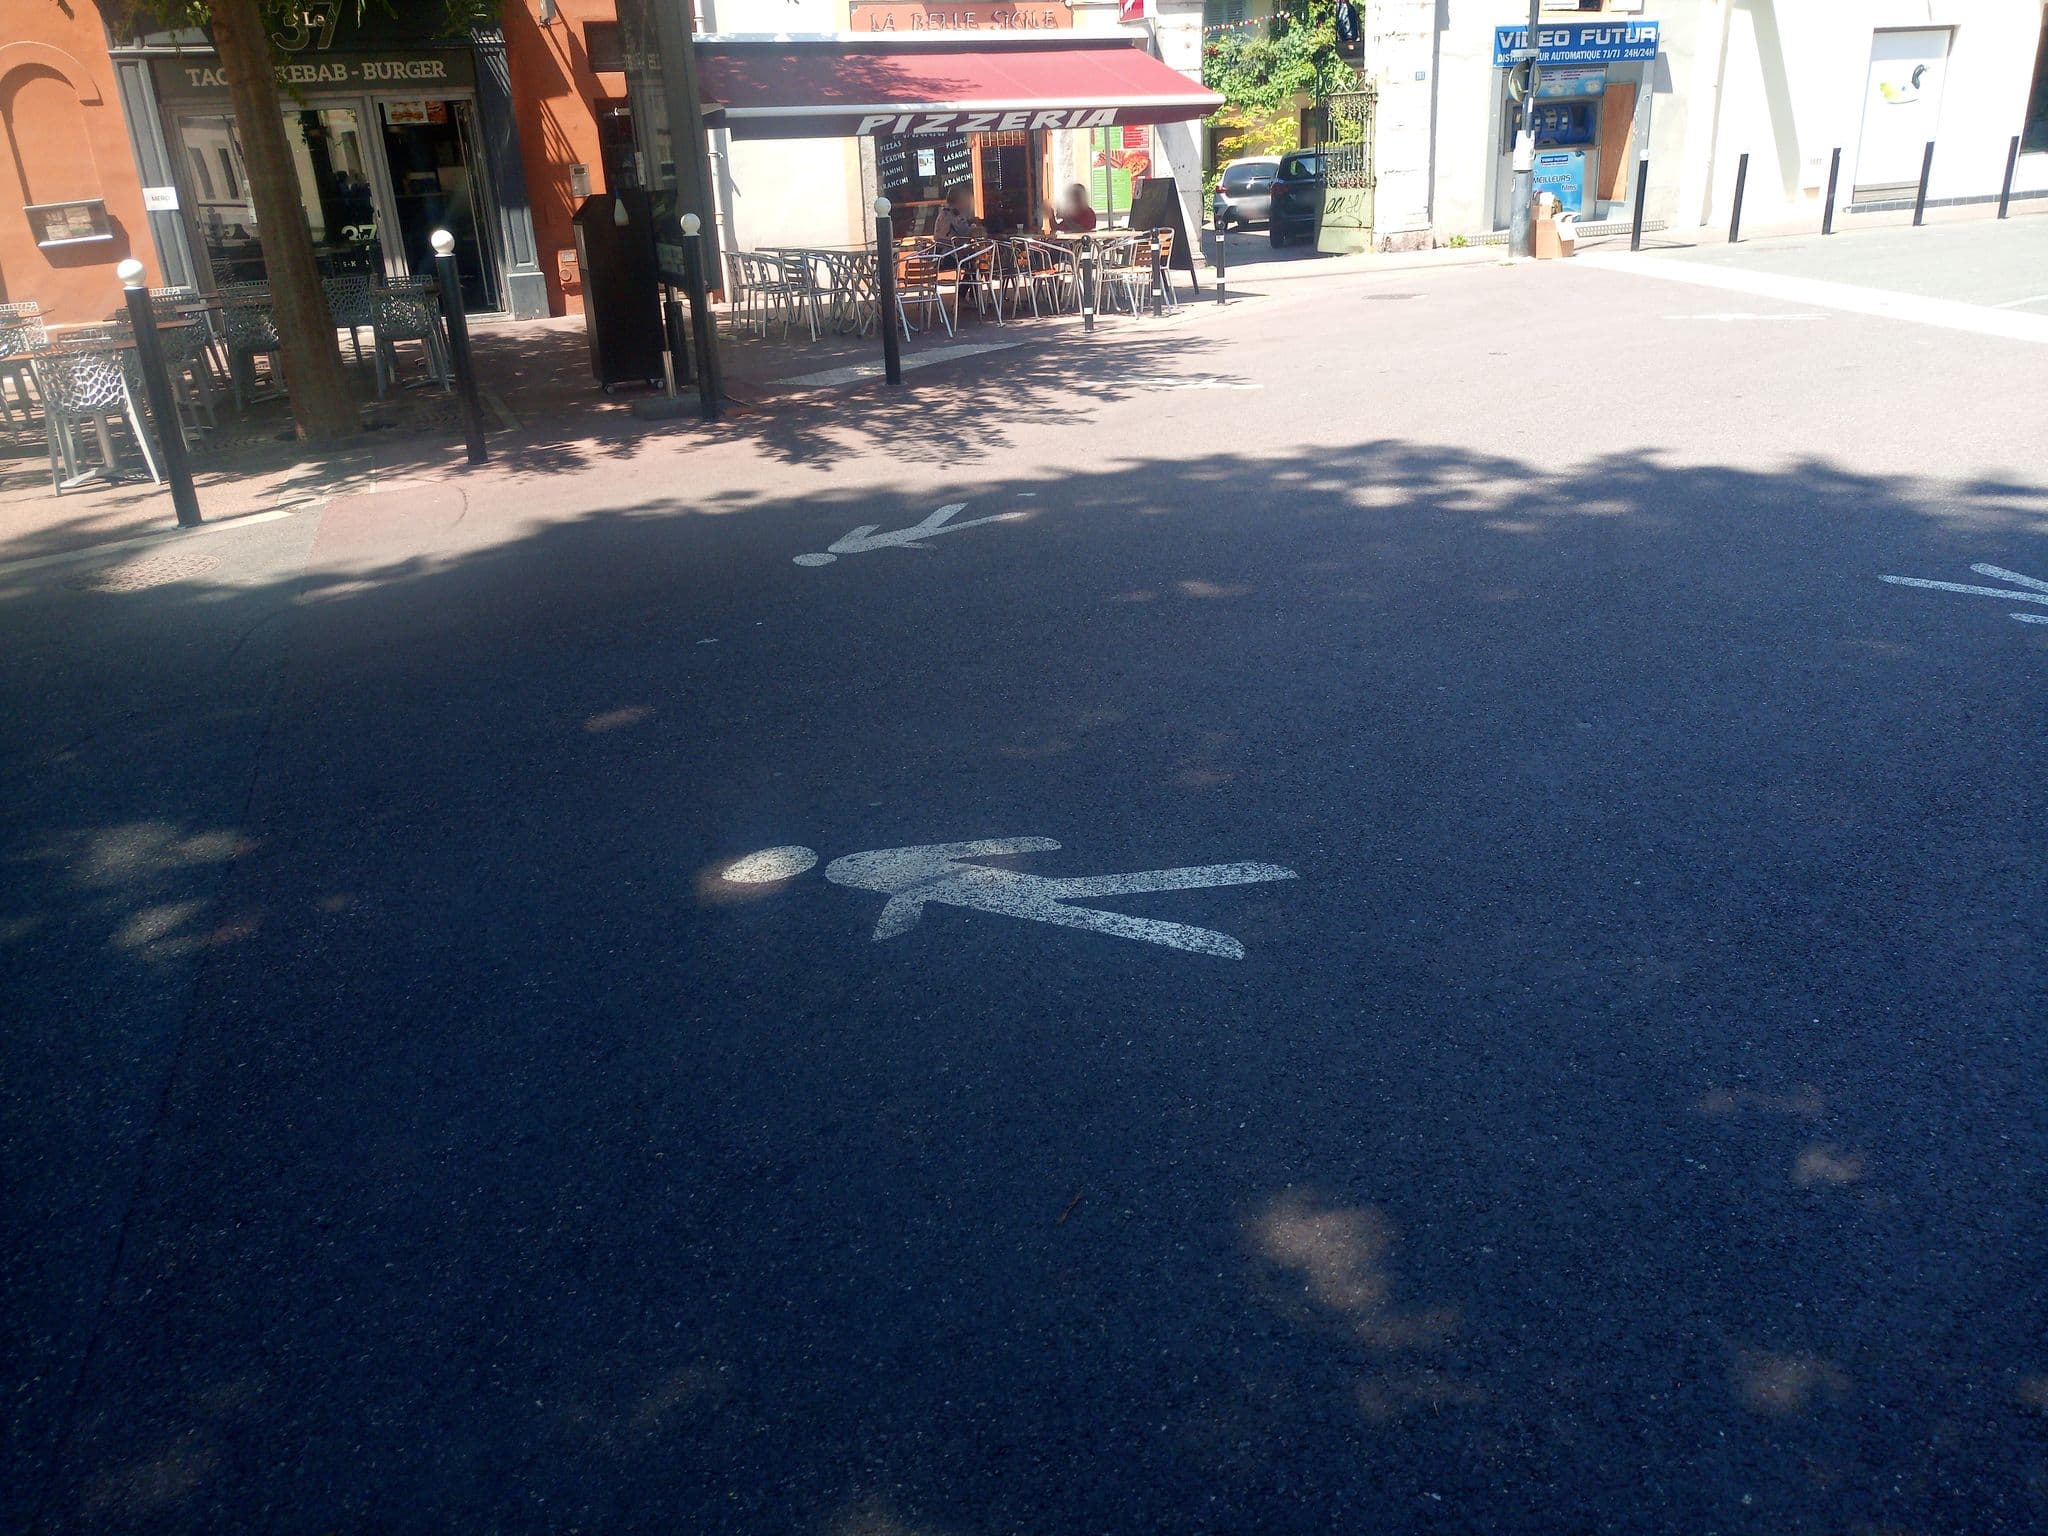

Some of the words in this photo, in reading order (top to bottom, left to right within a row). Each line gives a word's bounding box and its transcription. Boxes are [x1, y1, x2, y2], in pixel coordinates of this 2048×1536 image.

[272, 0, 343, 51] 37
[870, 13, 896, 31] LA
[911, 12, 979, 31] BELLE
[990, 10, 1059, 30] SICILE
[1580, 27, 1657, 46] FUTUR
[1551, 49, 1601, 61] AUTOMATIQUE
[1623, 47, 1655, 58] 24H/24H
[274, 63, 348, 83] KEBAB
[361, 60, 448, 80] BURGER
[855, 107, 1120, 136] PIZZERIA
[880, 140, 902, 152] PIZZAS
[945, 136, 967, 149] PIZZAS
[943, 148, 971, 162] LASAGNE
[882, 165, 904, 177] PANINI
[947, 161, 969, 174] PANINI
[943, 173, 974, 187] ARANCINI
[341, 224, 378, 241] 37
